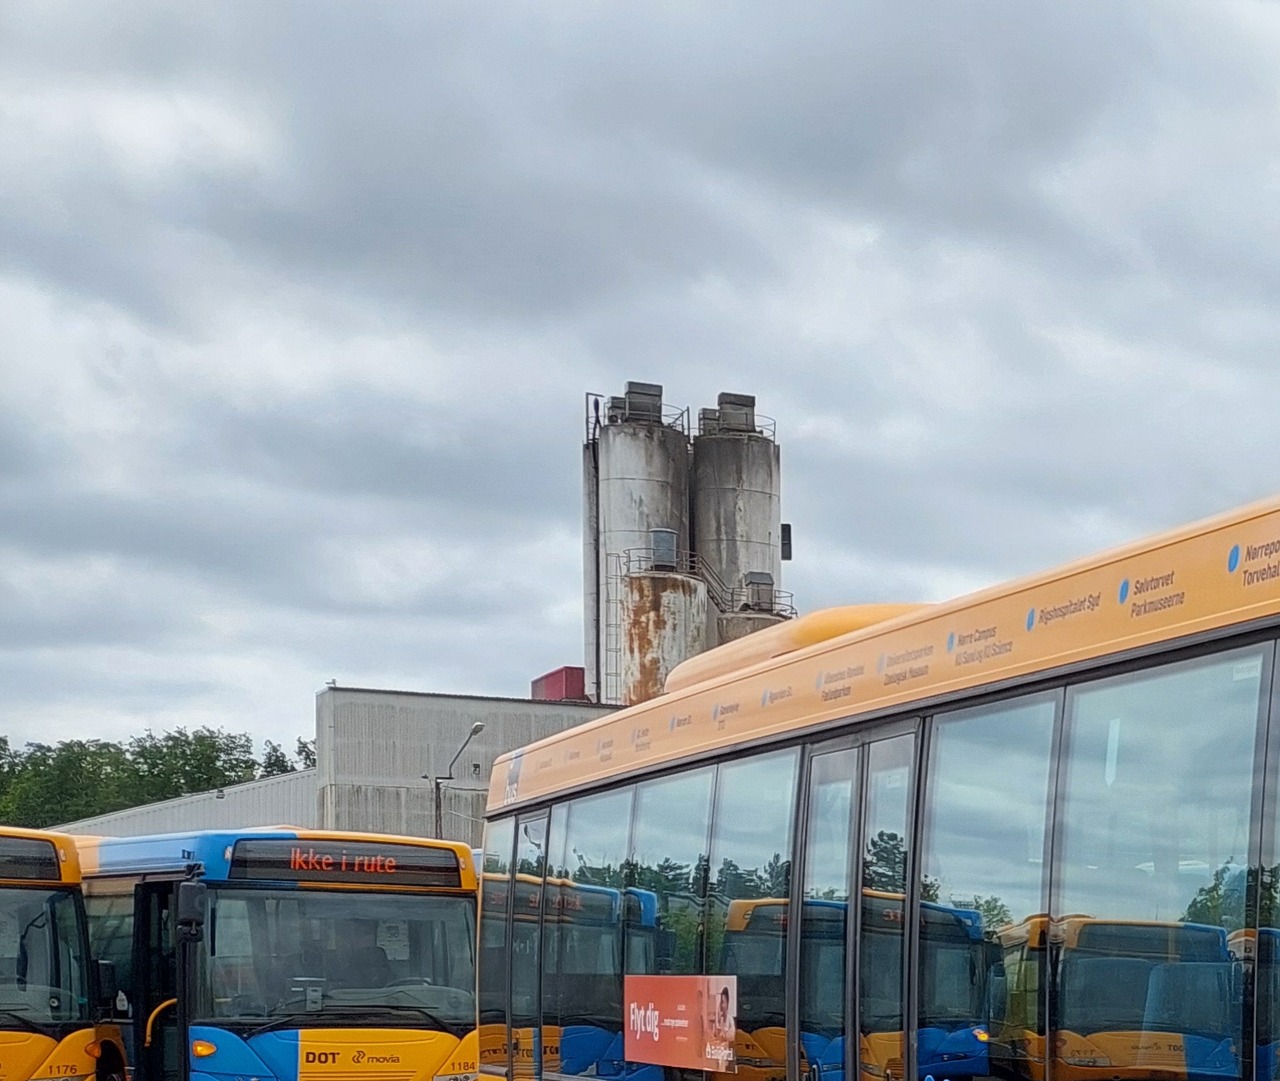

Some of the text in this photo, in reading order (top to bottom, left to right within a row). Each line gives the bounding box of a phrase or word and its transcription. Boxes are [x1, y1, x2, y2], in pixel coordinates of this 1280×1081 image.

[1130, 591, 1185, 618] Parkmuseerne
[290, 847, 397, 874] Ikke i rute
[630, 1001, 659, 1042] Flyt dig
[305, 1051, 400, 1064] DOT movia
[451, 1061, 476, 1071] 1184
[48, 1064, 77, 1075] 1176
